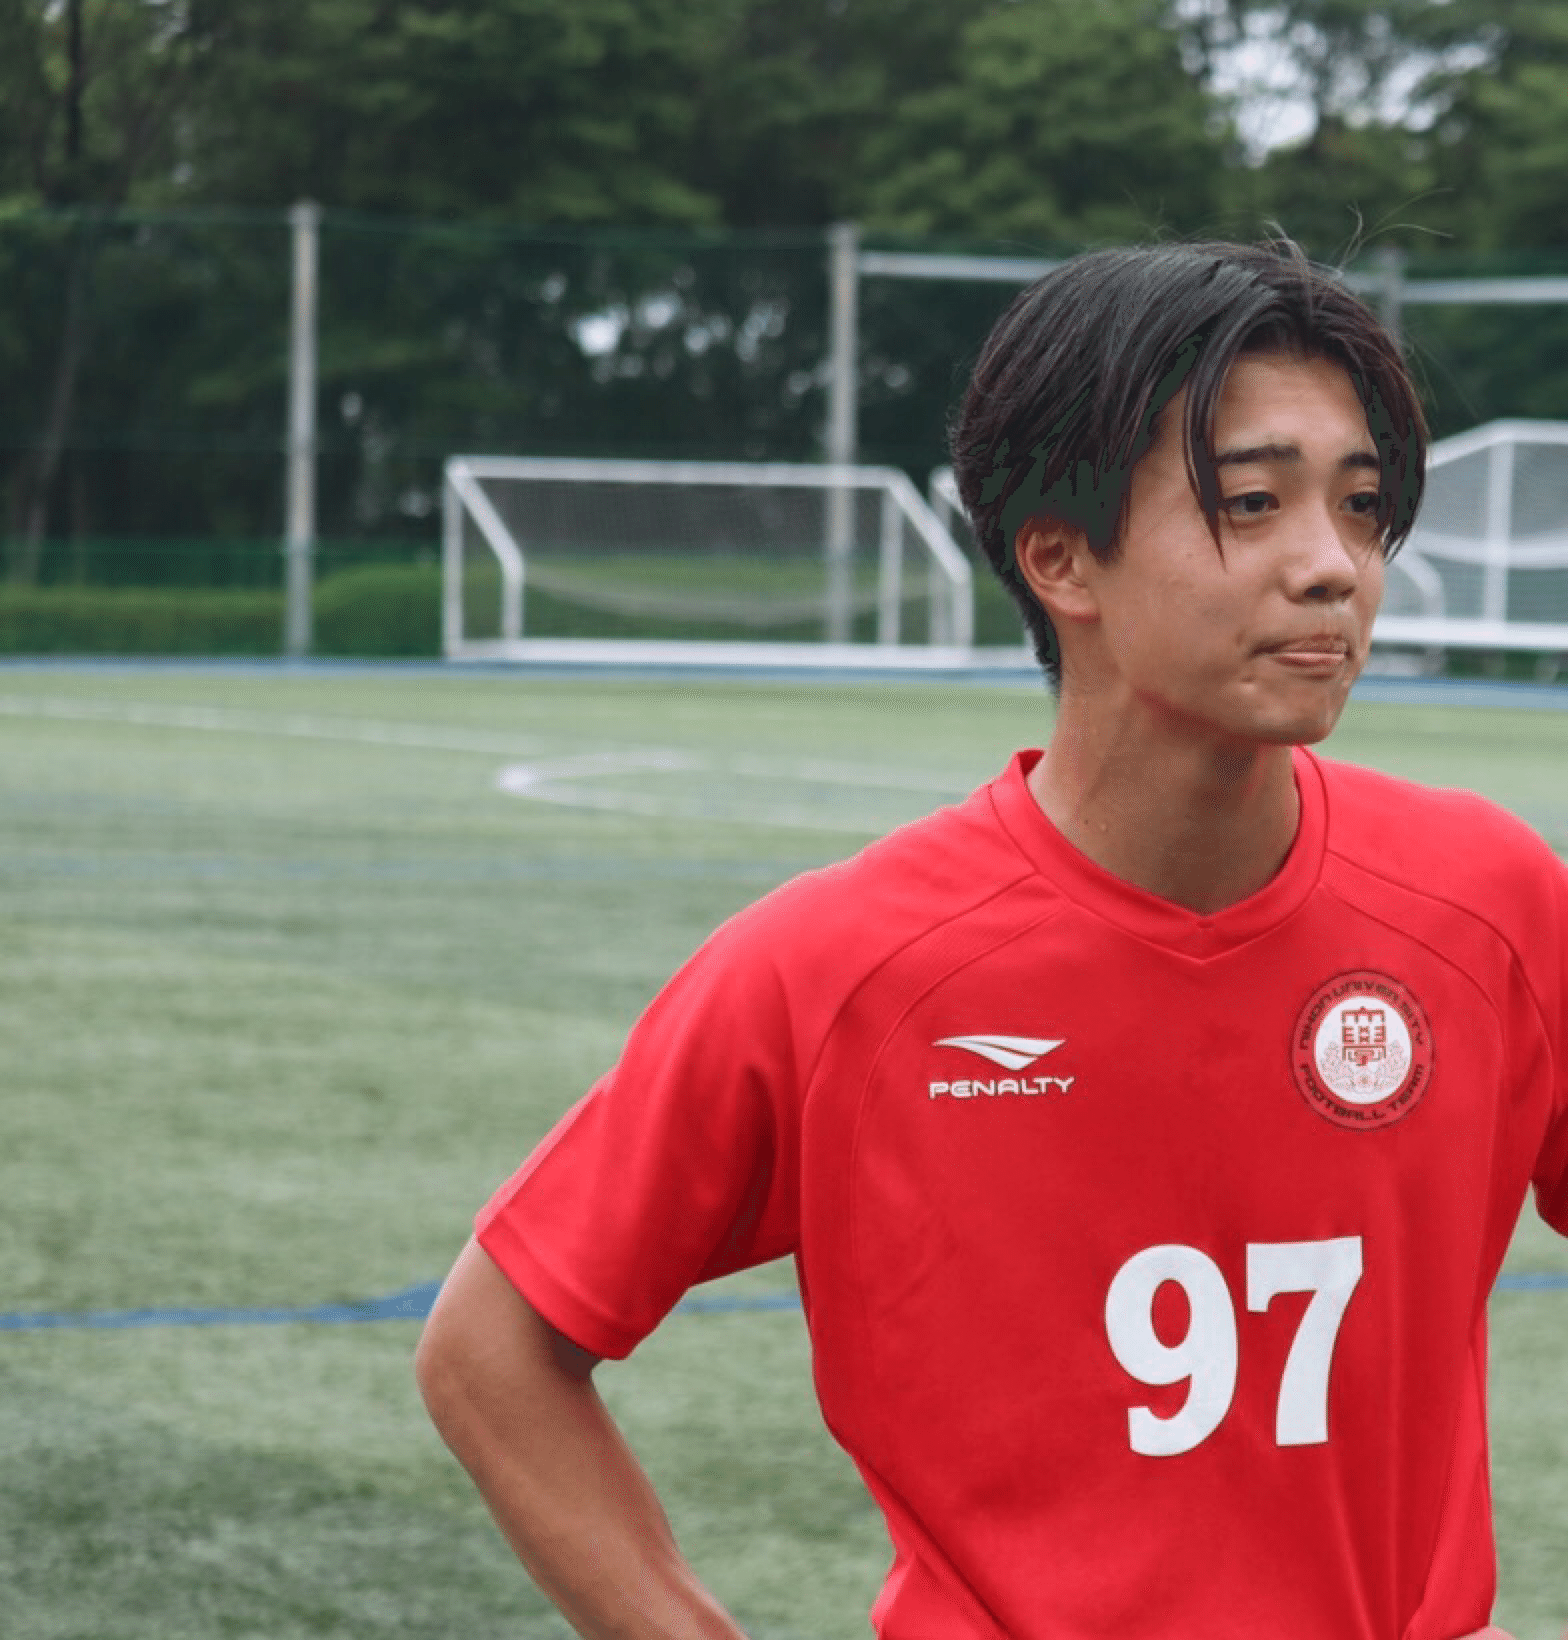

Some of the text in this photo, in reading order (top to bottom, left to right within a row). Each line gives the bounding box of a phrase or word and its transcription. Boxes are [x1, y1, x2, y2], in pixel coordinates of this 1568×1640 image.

[929, 1076, 1075, 1100] PENALTY
[1299, 1063, 1425, 1121] FOOTBALL TEAM
[1105, 1235, 1363, 1457] 97
